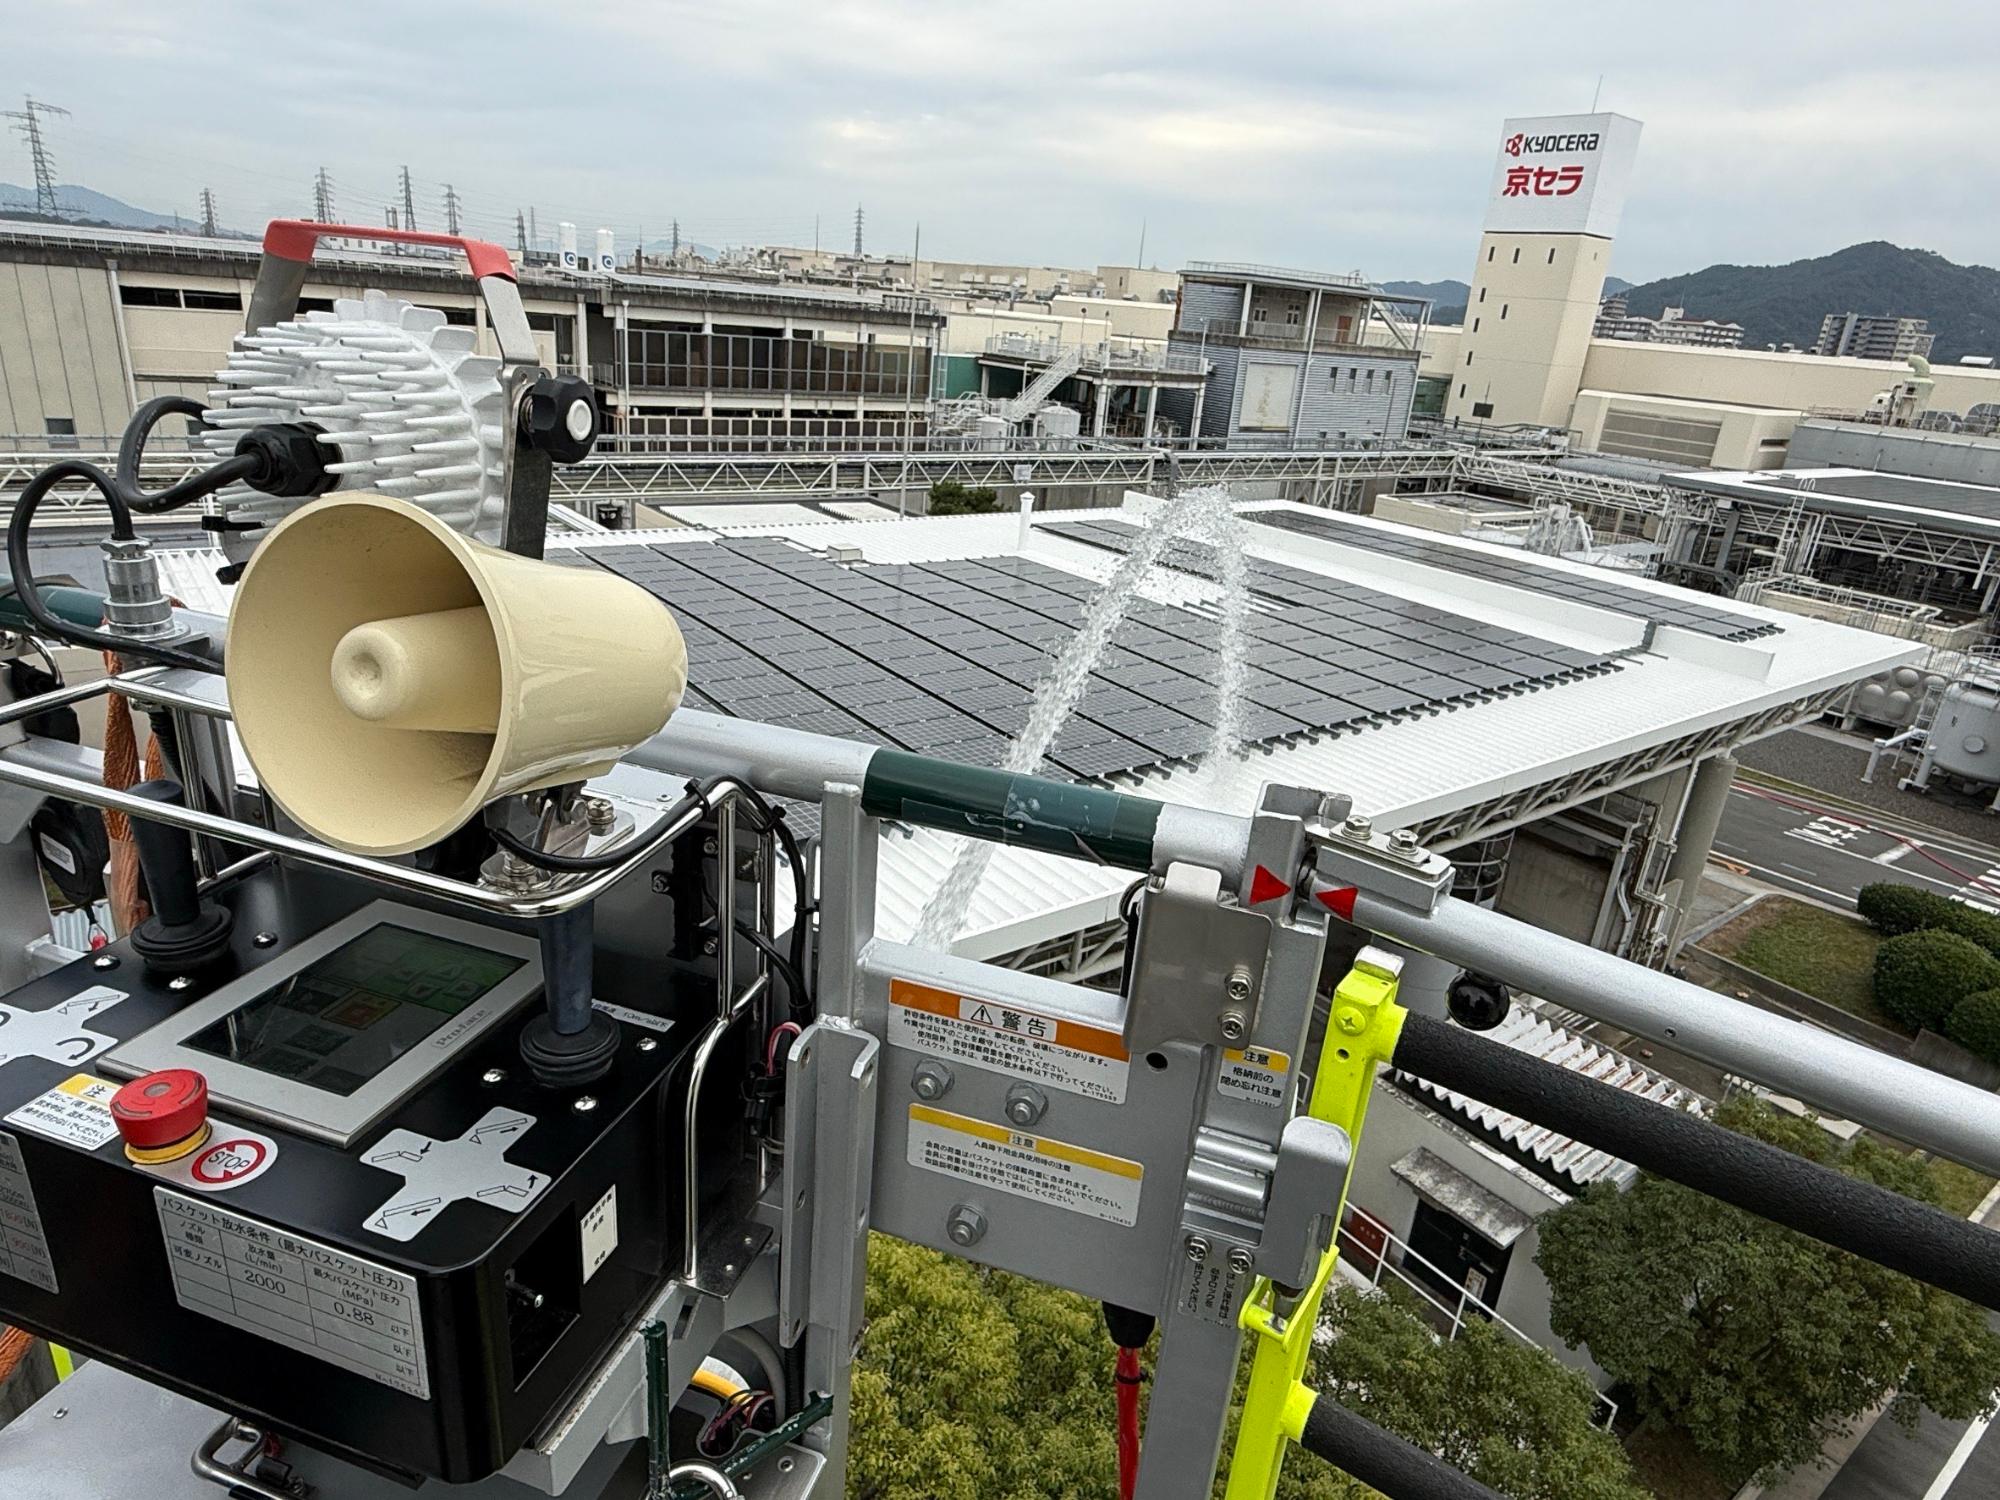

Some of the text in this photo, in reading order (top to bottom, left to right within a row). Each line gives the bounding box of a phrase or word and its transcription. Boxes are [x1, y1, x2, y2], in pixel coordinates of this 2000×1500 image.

[1522, 133, 1600, 154] KYOCERA
[1502, 165, 1585, 197] 京セラ
[1001, 1010, 1047, 1038] 警告
[1243, 1050, 1270, 1066] 注意
[1012, 1134, 1034, 1149] 注意
[208, 1150, 251, 1170] STOP
[179, 1220, 206, 1235] ノズル
[173, 1244, 222, 1269] 可変ノズル
[244, 1252, 283, 1274] (L/min)
[244, 1269, 286, 1295] 2000
[313, 1266, 400, 1306] 最大バスケット圧力
[341, 1287, 375, 1308] (MPa)
[333, 1301, 375, 1326] 0.88
[390, 1324, 410, 1338] 以下
[393, 1343, 412, 1357] 以下
[396, 1363, 415, 1377] 以下
